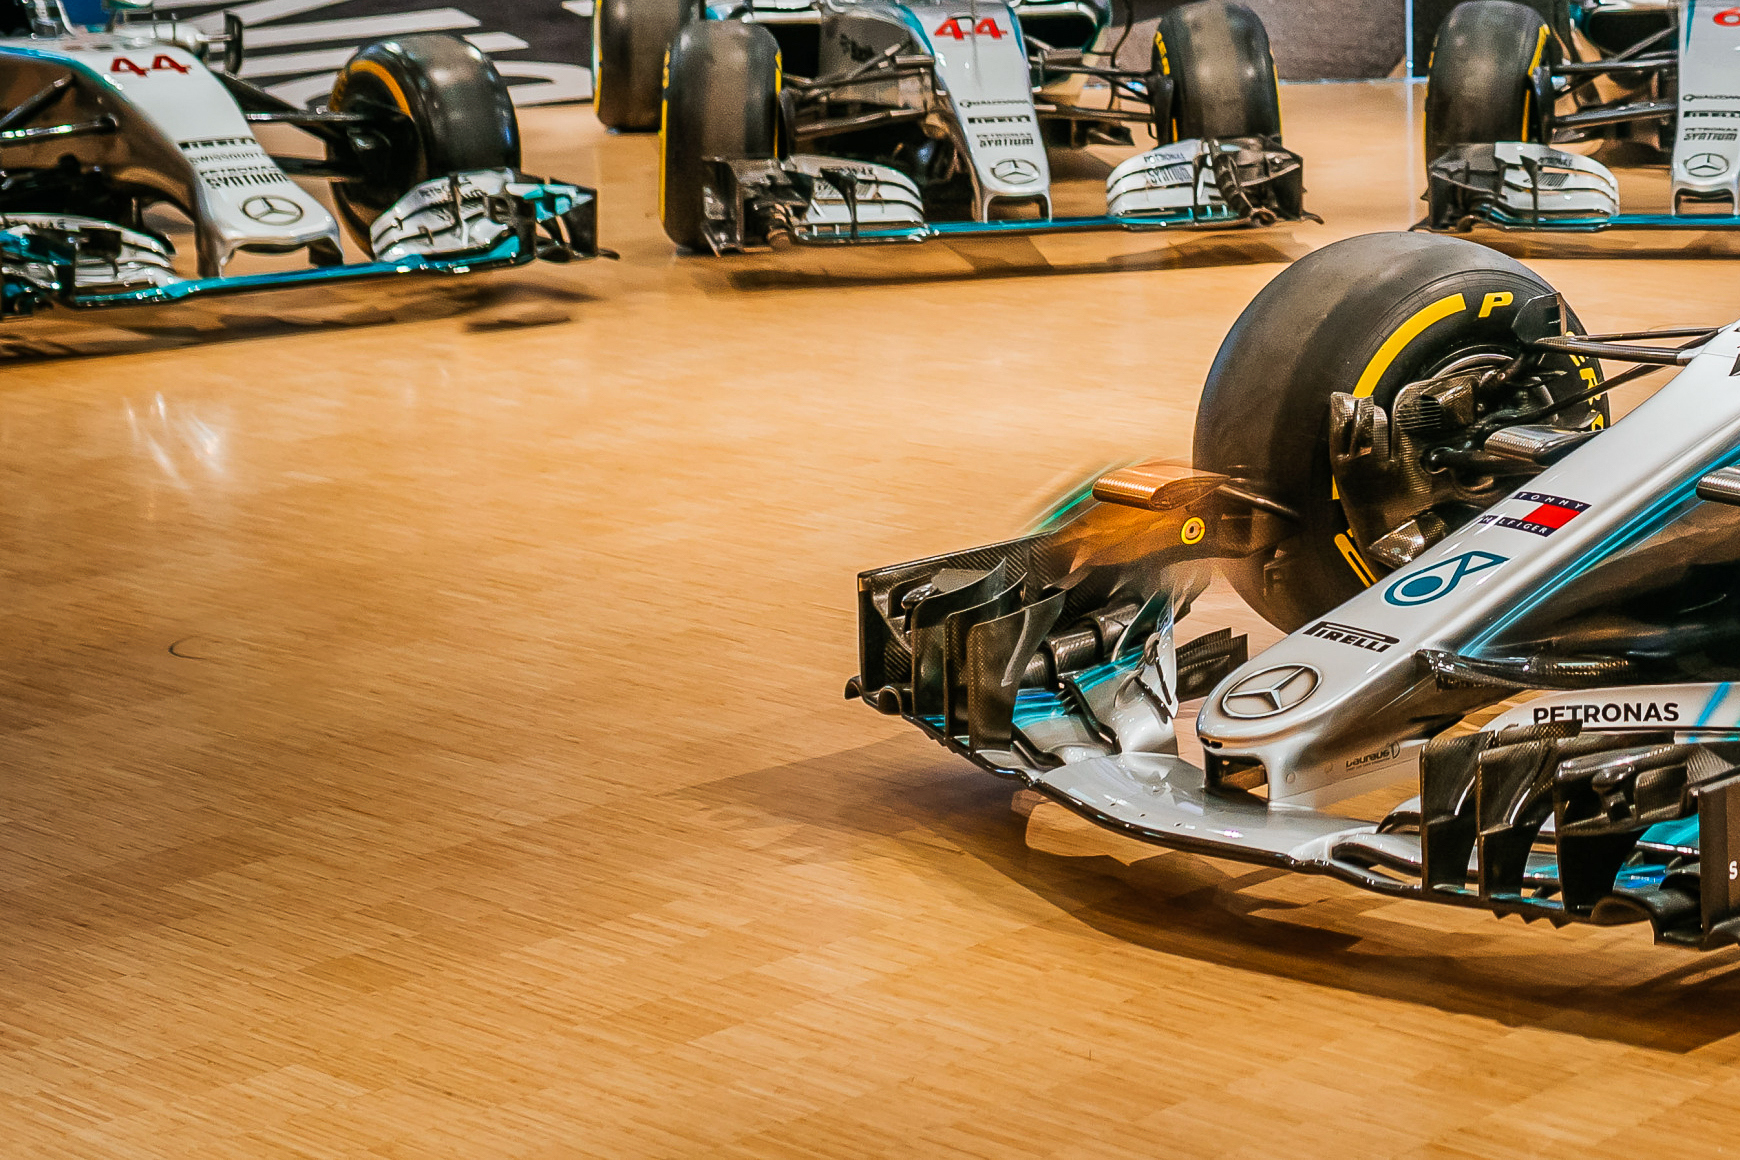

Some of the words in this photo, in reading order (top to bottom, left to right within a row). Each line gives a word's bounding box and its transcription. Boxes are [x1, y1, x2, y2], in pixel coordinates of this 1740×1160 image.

[934, 17, 1008, 41] 44
[110, 53, 192, 77] 44
[1519, 492, 1584, 510] TOMMY
[1482, 515, 1549, 535] HLFIGER
[1302, 620, 1401, 654] PIRELLI
[1532, 701, 1680, 725] PETRONAS
